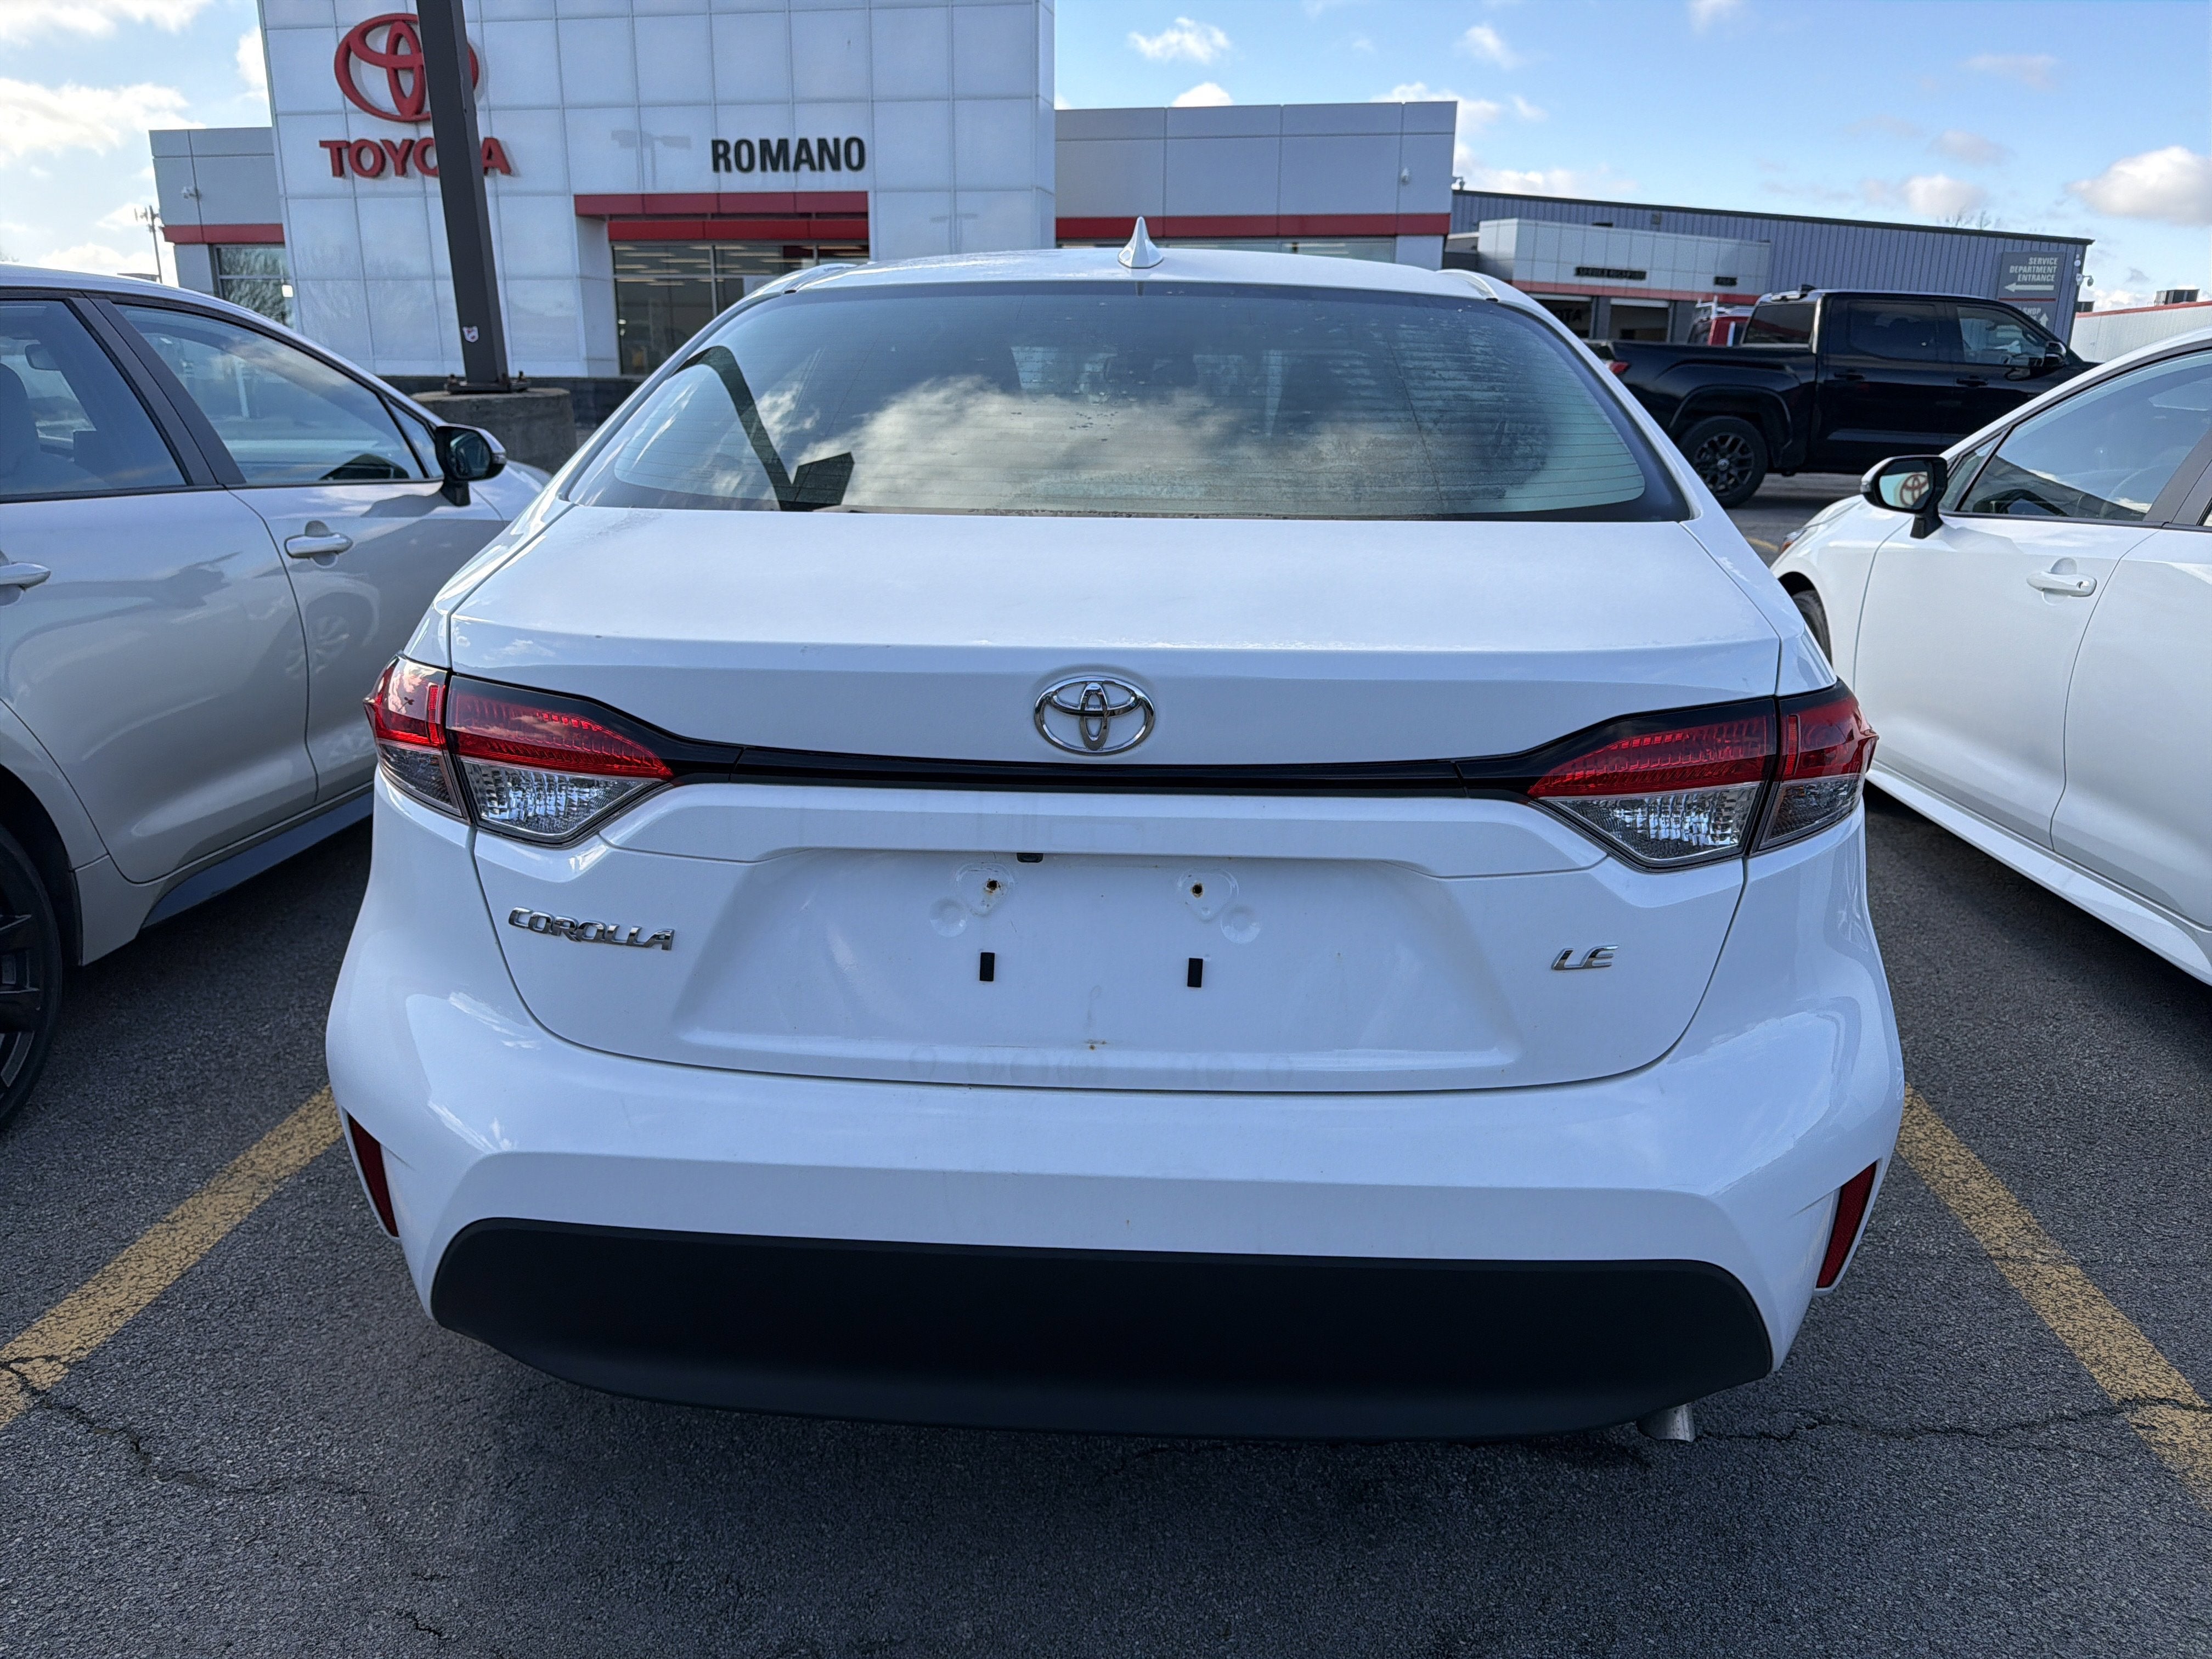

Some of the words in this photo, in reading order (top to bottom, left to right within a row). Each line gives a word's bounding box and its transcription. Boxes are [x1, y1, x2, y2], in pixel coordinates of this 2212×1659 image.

[318, 137, 512, 178] TOYOA
[711, 136, 866, 173] ROMANO
[2028, 257, 2058, 265] SERVICE
[508, 906, 675, 951] COROLLA
[1550, 944, 1619, 971] LE
